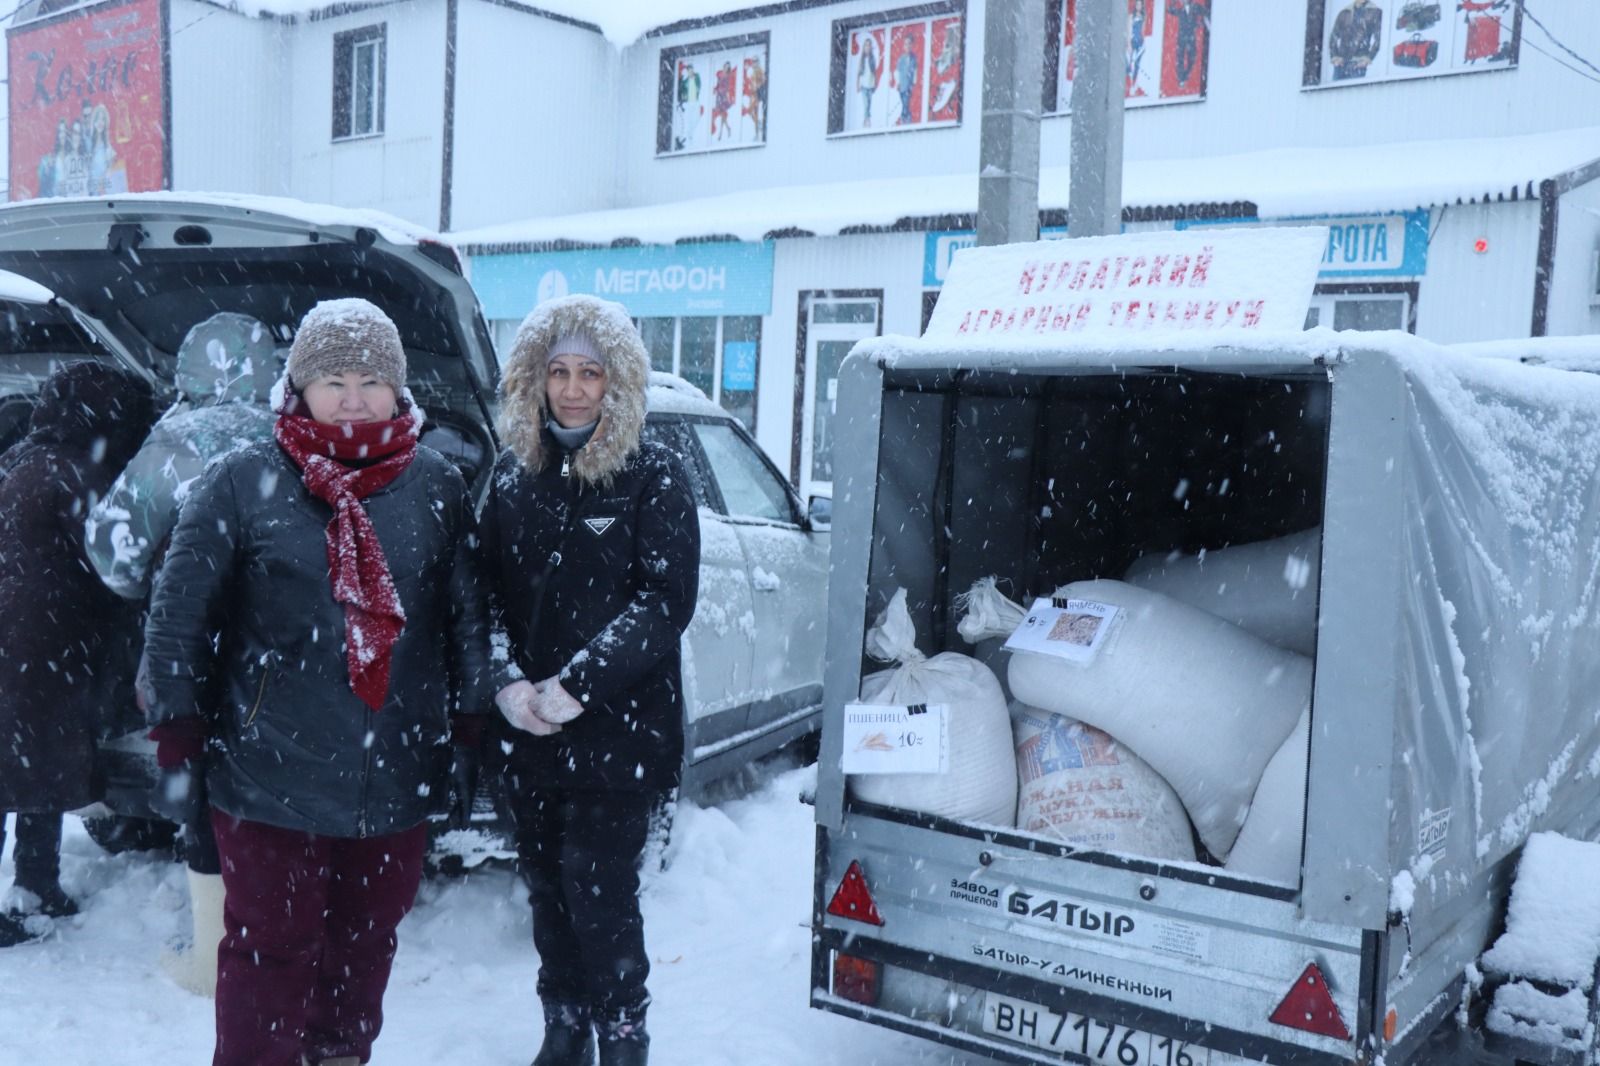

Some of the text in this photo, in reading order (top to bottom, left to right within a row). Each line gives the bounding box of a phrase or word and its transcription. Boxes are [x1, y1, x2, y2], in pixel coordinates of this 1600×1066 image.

[1321, 223, 1388, 263] РОТА
[848, 713, 909, 724] ПШЕНИЦА
[950, 878, 1000, 898] ЗАВОД
[950, 889, 999, 909] ПРИЦЕПОВ
[1007, 891, 1135, 937] БАТЫР
[1158, 1037, 1193, 1066] 16
